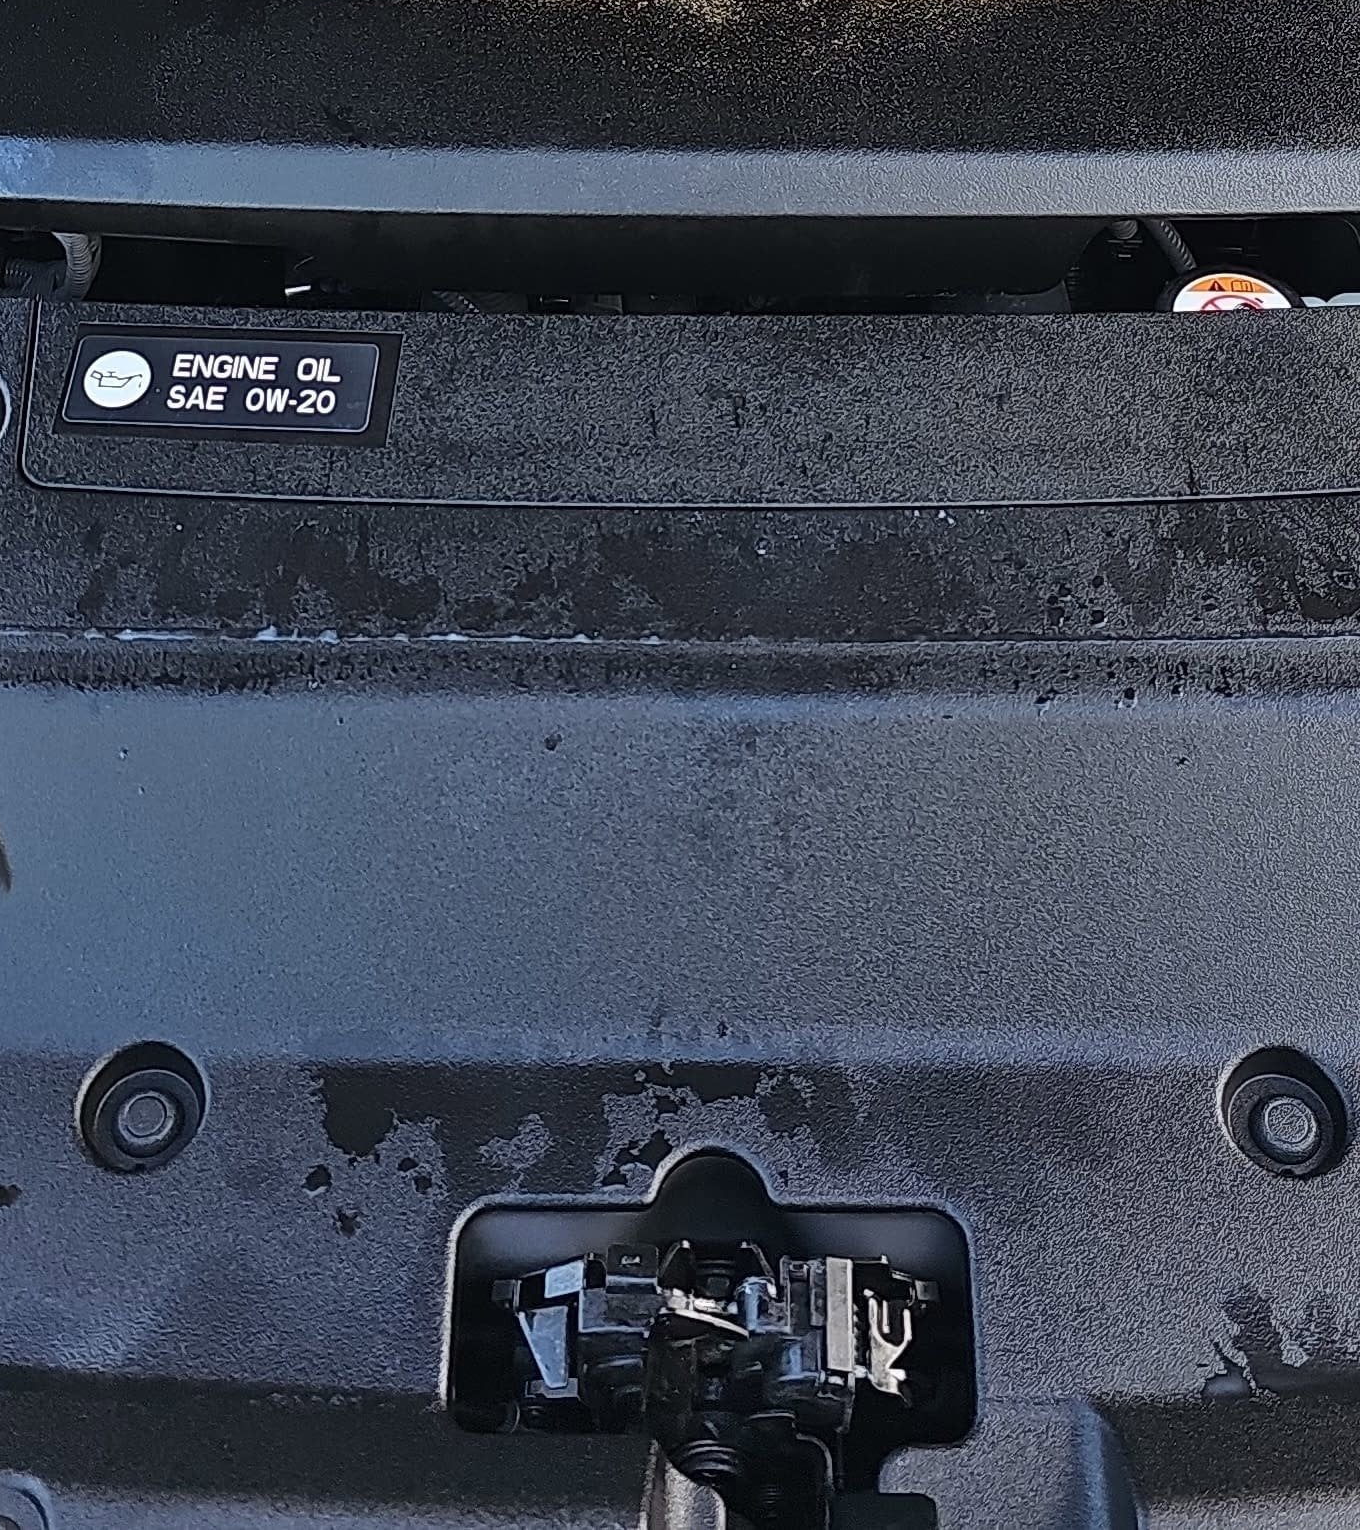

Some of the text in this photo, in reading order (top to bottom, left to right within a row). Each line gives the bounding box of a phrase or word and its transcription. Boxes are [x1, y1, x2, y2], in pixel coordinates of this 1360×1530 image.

[172, 354, 342, 383] ENGINE OIL
[167, 386, 336, 415] SAE 0W-20
